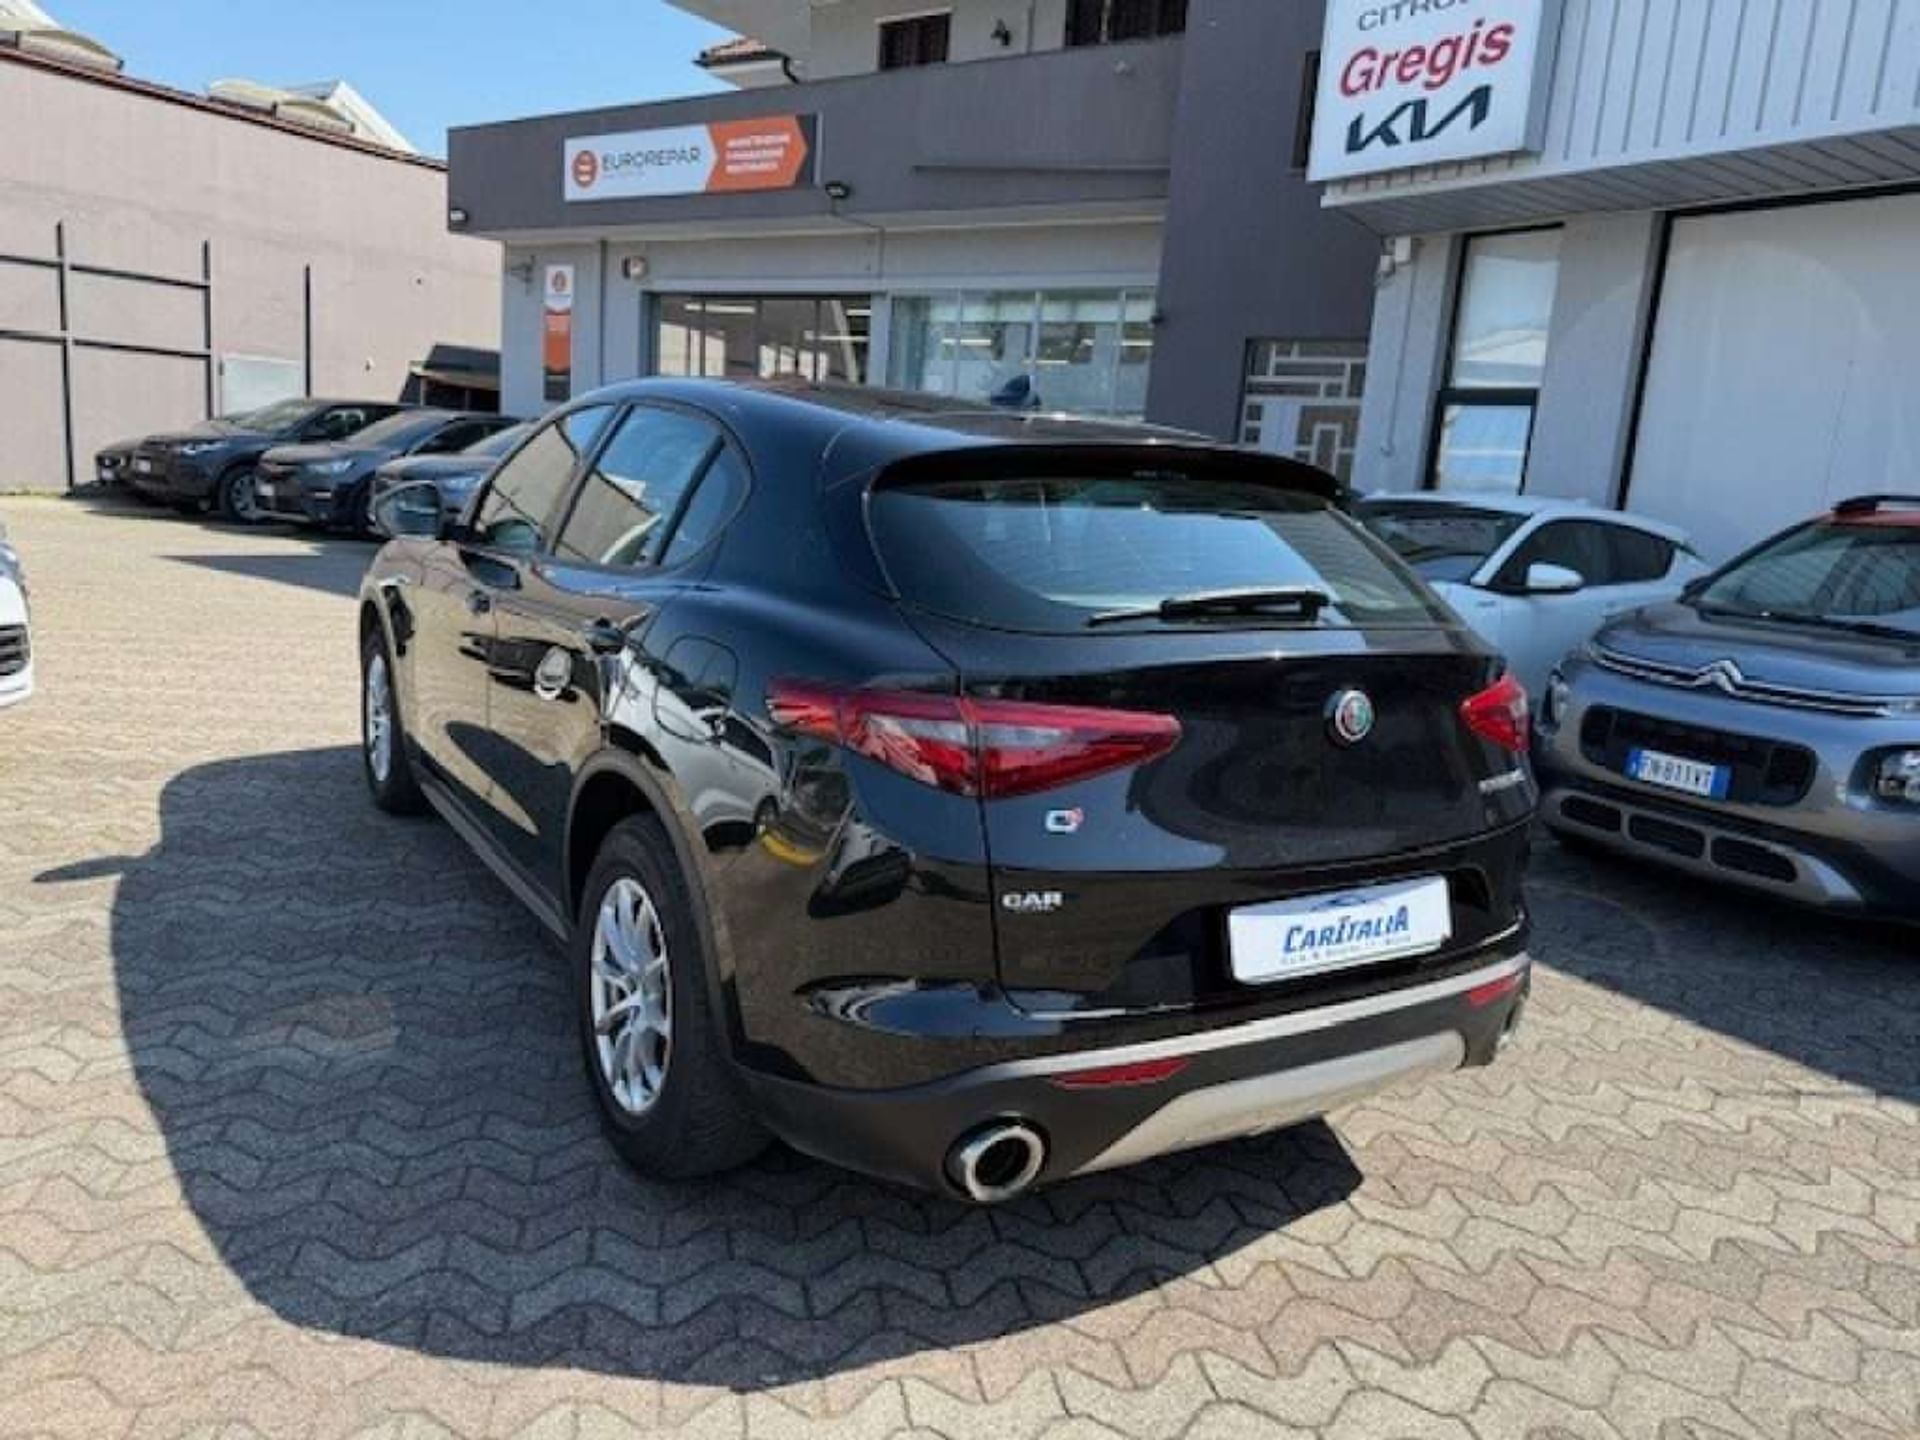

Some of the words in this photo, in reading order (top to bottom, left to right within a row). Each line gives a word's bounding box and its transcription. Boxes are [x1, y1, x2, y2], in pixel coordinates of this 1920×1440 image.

[1340, 19, 1515, 97] Gregis
[1345, 85, 1492, 154] KIA
[602, 147, 701, 172] EUROREPAR
